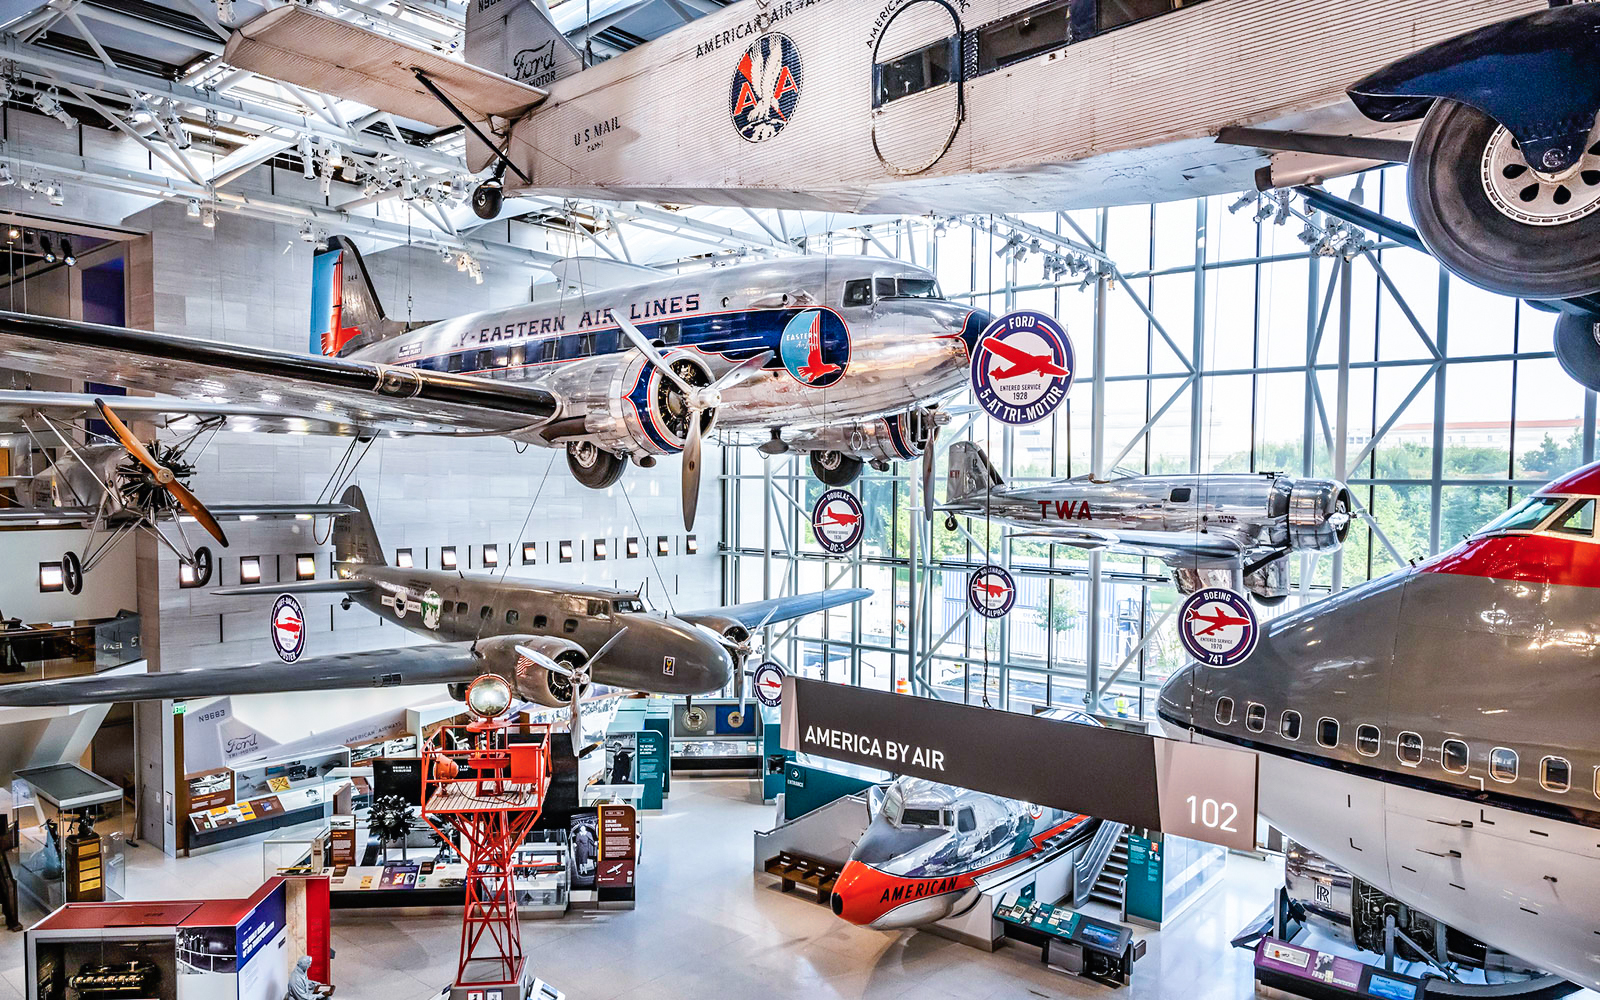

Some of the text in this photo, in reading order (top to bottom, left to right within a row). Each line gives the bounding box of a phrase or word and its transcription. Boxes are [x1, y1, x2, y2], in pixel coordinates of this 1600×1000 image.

[513, 40, 556, 81] Ford
[594, 116, 621, 137] MAIL
[579, 308, 615, 328] AIR
[630, 294, 700, 319] LINES
[1009, 316, 1035, 329] FORD
[980, 386, 1064, 422] 5-AT TRI-MOTOR
[1013, 392, 1028, 400] 1928
[1038, 500, 1092, 520] TWA
[830, 543, 845, 552] DC-3
[1204, 591, 1231, 602] BOEING
[1208, 653, 1223, 664] 747
[198, 709, 225, 723] N9683
[226, 734, 257, 753] Ford
[345, 731, 375, 744] AMERICAN
[805, 725, 945, 771] AMERICA BY AIR
[1186, 795, 1238, 832] 102
[880, 877, 958, 903] AMERICAN
